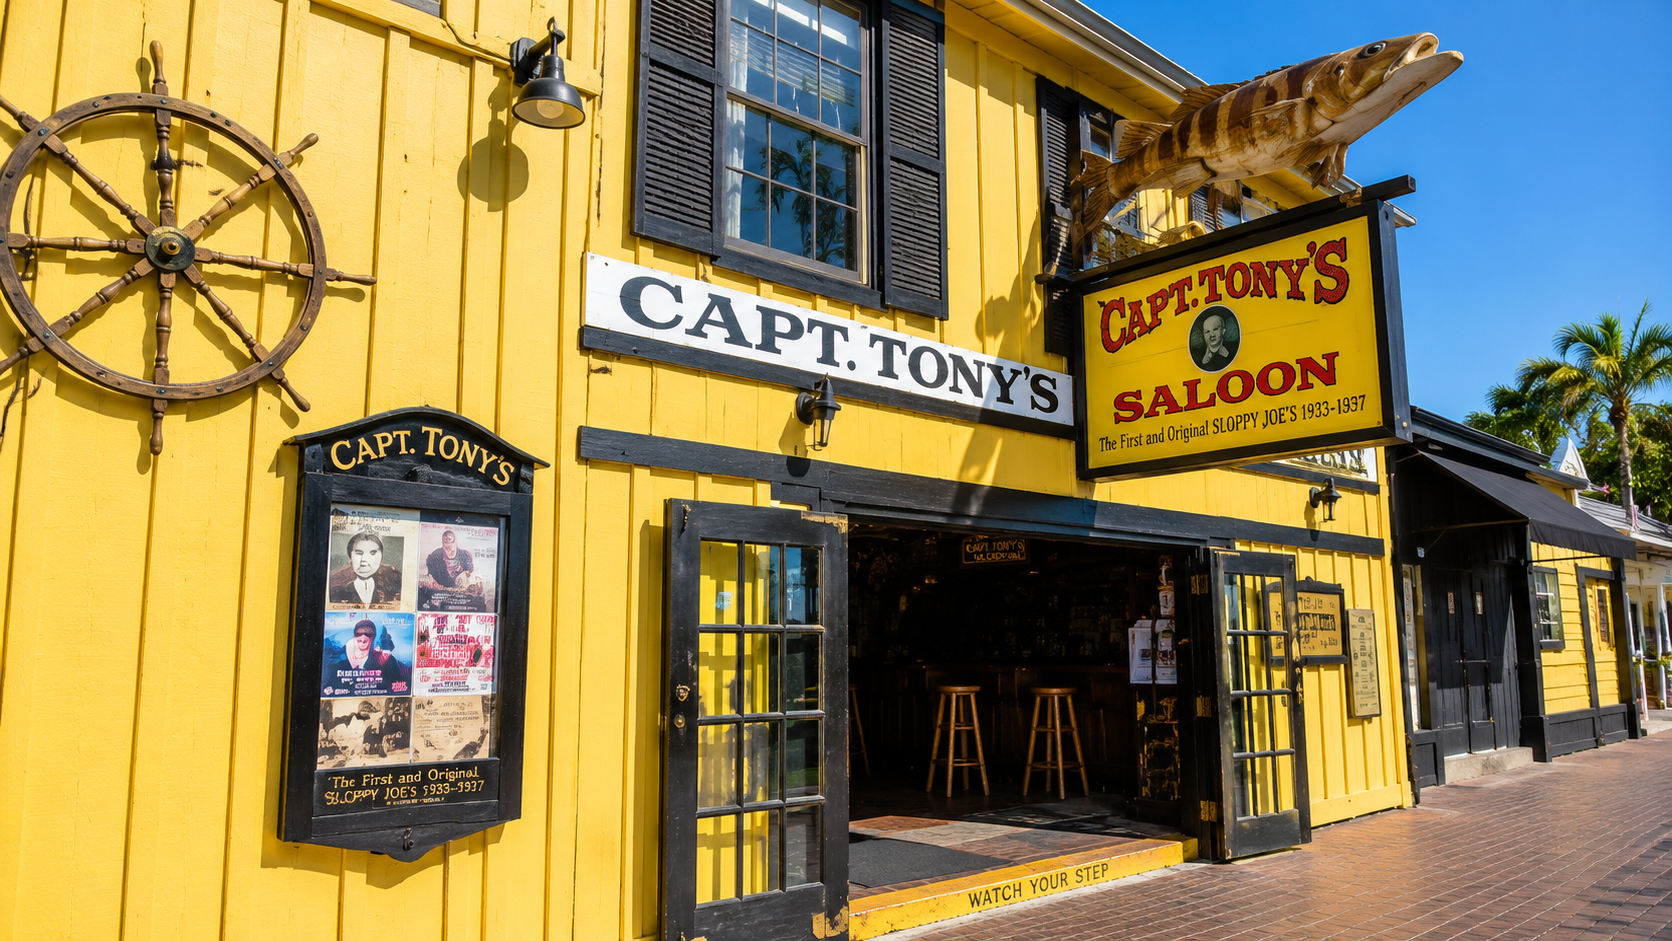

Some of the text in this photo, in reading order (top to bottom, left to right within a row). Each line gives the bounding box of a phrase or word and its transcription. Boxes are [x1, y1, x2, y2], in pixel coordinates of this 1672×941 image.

[1099, 236, 1350, 354] CAPT. TONY'S
[619, 275, 1059, 414] CAPT. TONY'S
[1113, 351, 1340, 425] SALOON
[1098, 394, 1367, 453] The First and Original SLOPPY JOE'S 1933-1937
[330, 425, 516, 486] CAPT. TONY'S
[331, 766, 480, 789] The First and Original
[383, 786, 418, 800] JOE'S
[968, 862, 1110, 909] WATCH YOUR STEP
